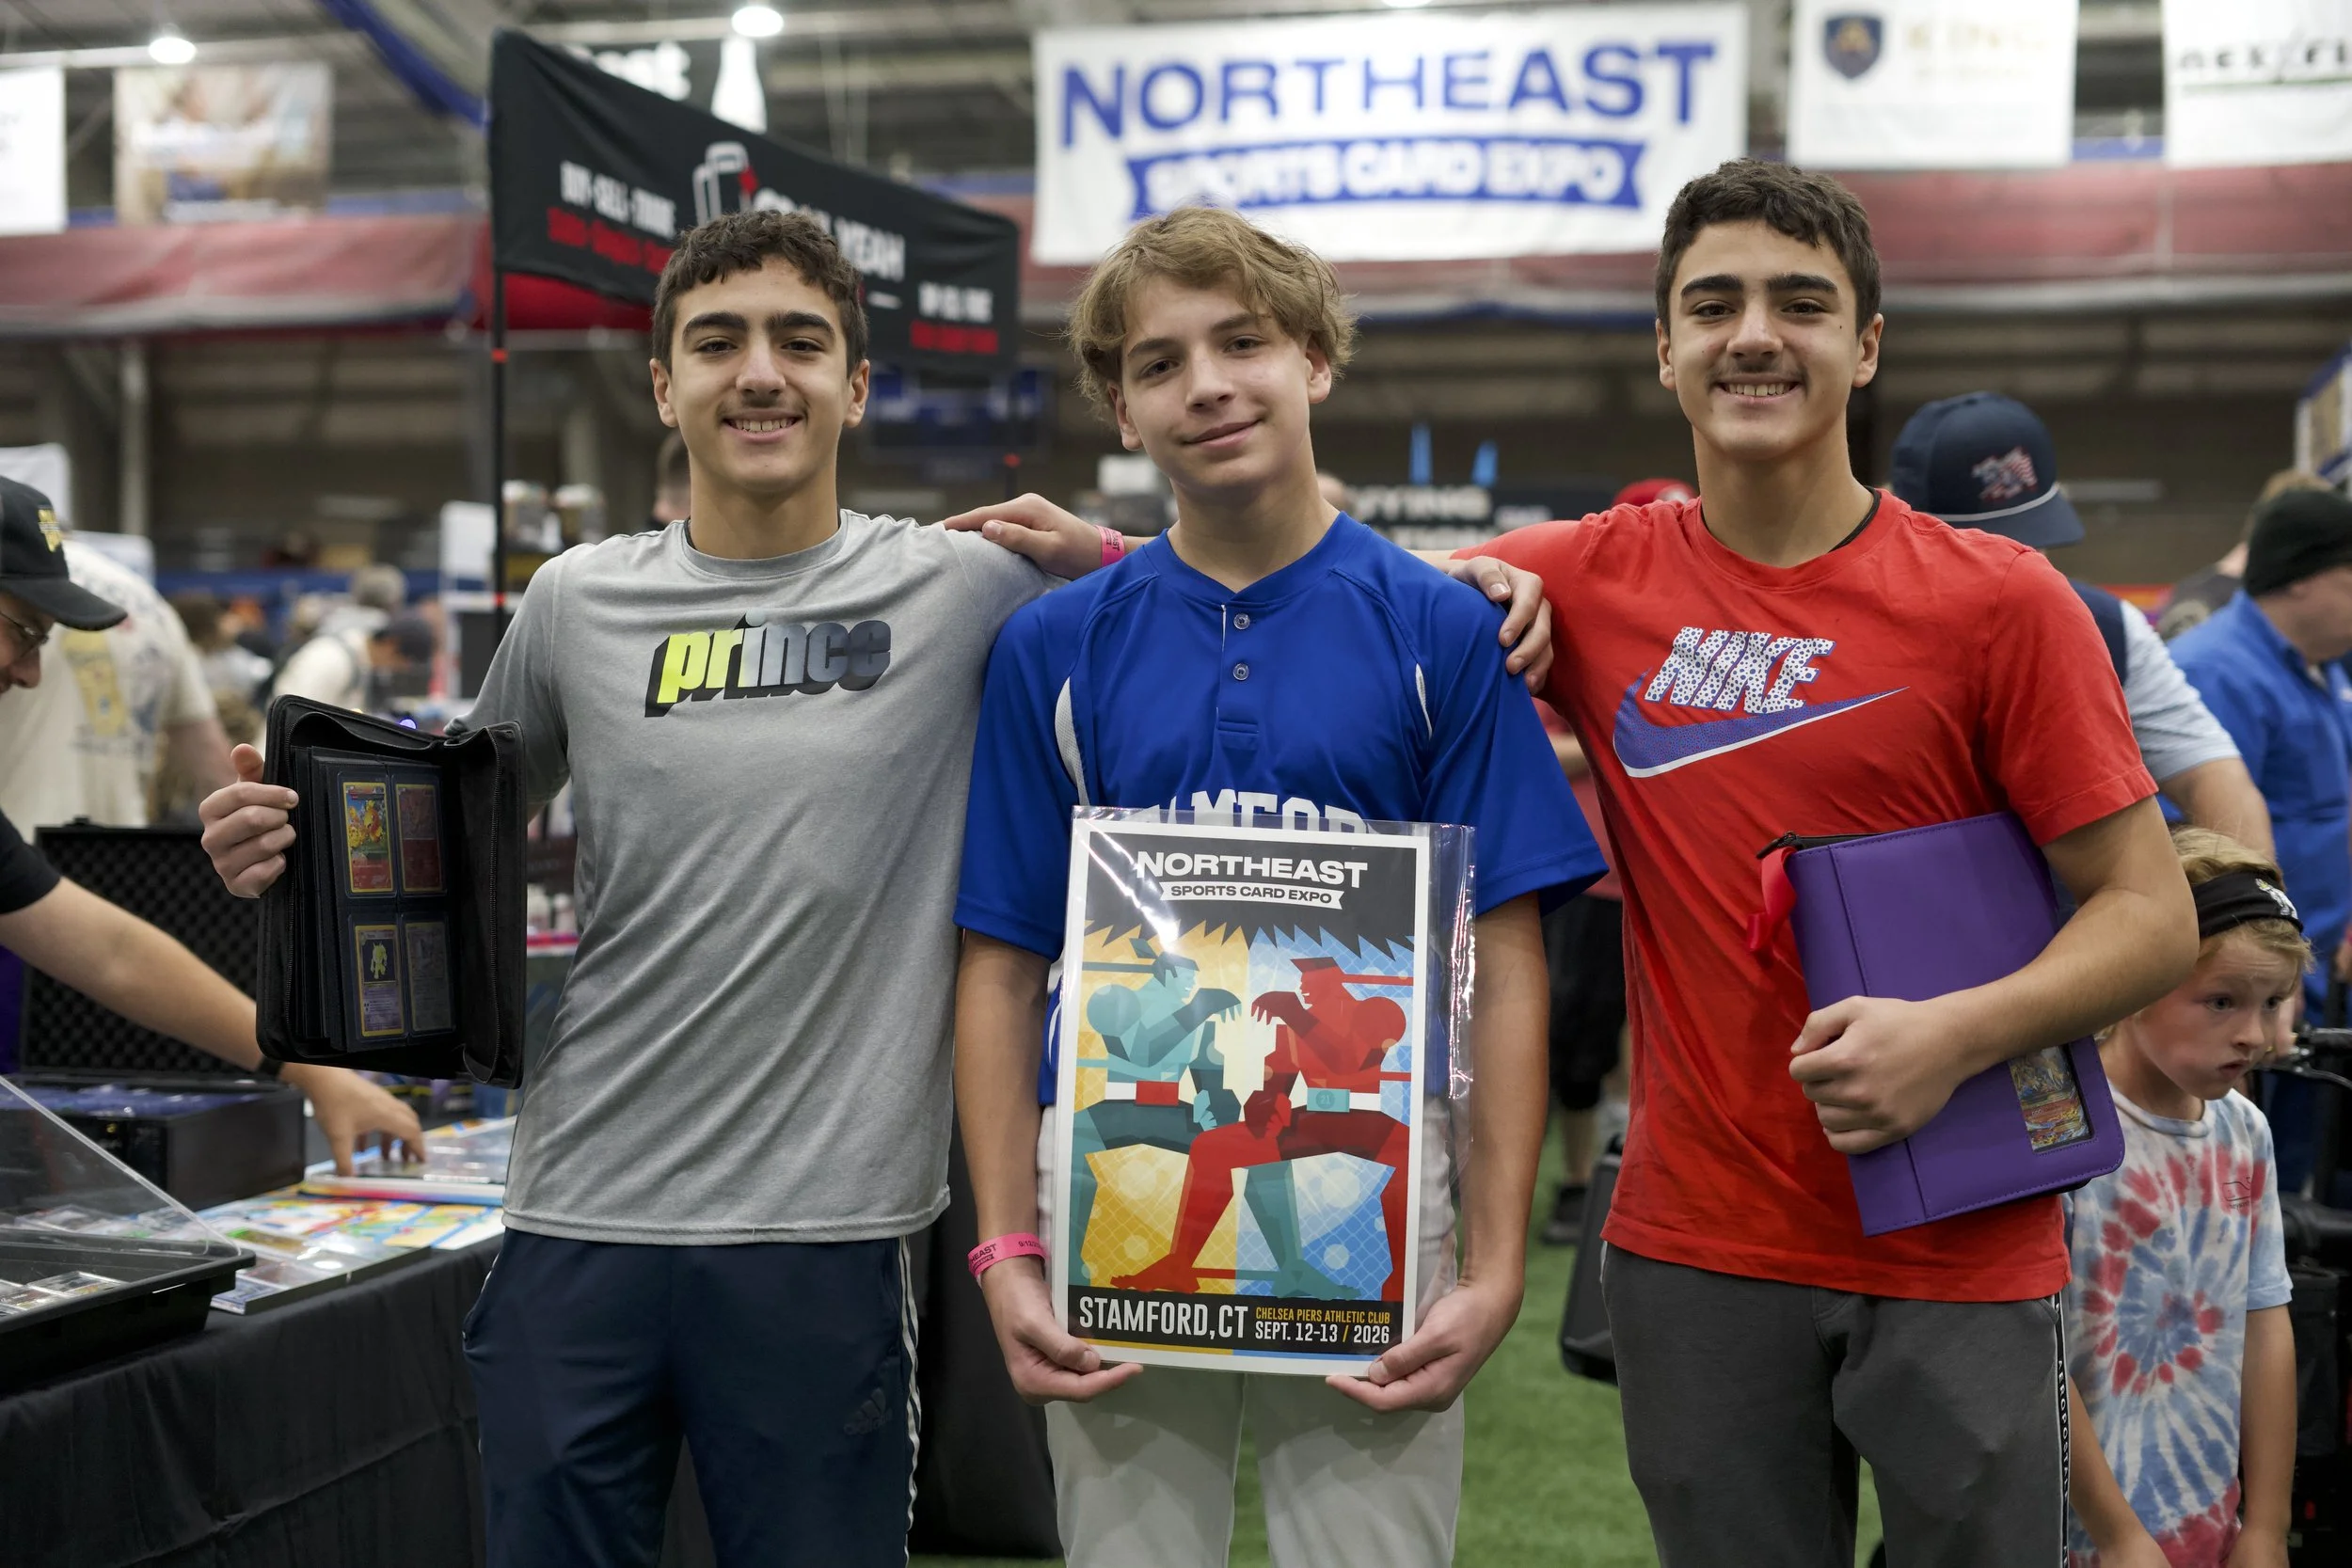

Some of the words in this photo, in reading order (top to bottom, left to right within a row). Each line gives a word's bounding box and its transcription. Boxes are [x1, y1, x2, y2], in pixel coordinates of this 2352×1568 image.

[1060, 41, 1716, 149] NORTHEAST
[1344, 138, 1482, 200] CARD
[1486, 139, 1626, 204] EXPO
[644, 610, 892, 718] prince
[1644, 625, 1836, 715] NIKE
[1136, 850, 1369, 889] NORTHEAST
[1170, 885, 1237, 897] SPORTS
[1239, 886, 1285, 899] CARD
[1288, 889, 1332, 904] EXPO
[1255, 1307, 1295, 1321] CHELSEA
[1297, 1308, 1323, 1323] PIERS
[1324, 1309, 1365, 1324] ATHLETIC
[1367, 1311, 1391, 1324] CLUB
[1255, 1321, 1292, 1340] SEPT.
[1295, 1323, 1338, 1343] 12-13
[1353, 1324, 1391, 1344] 2026
